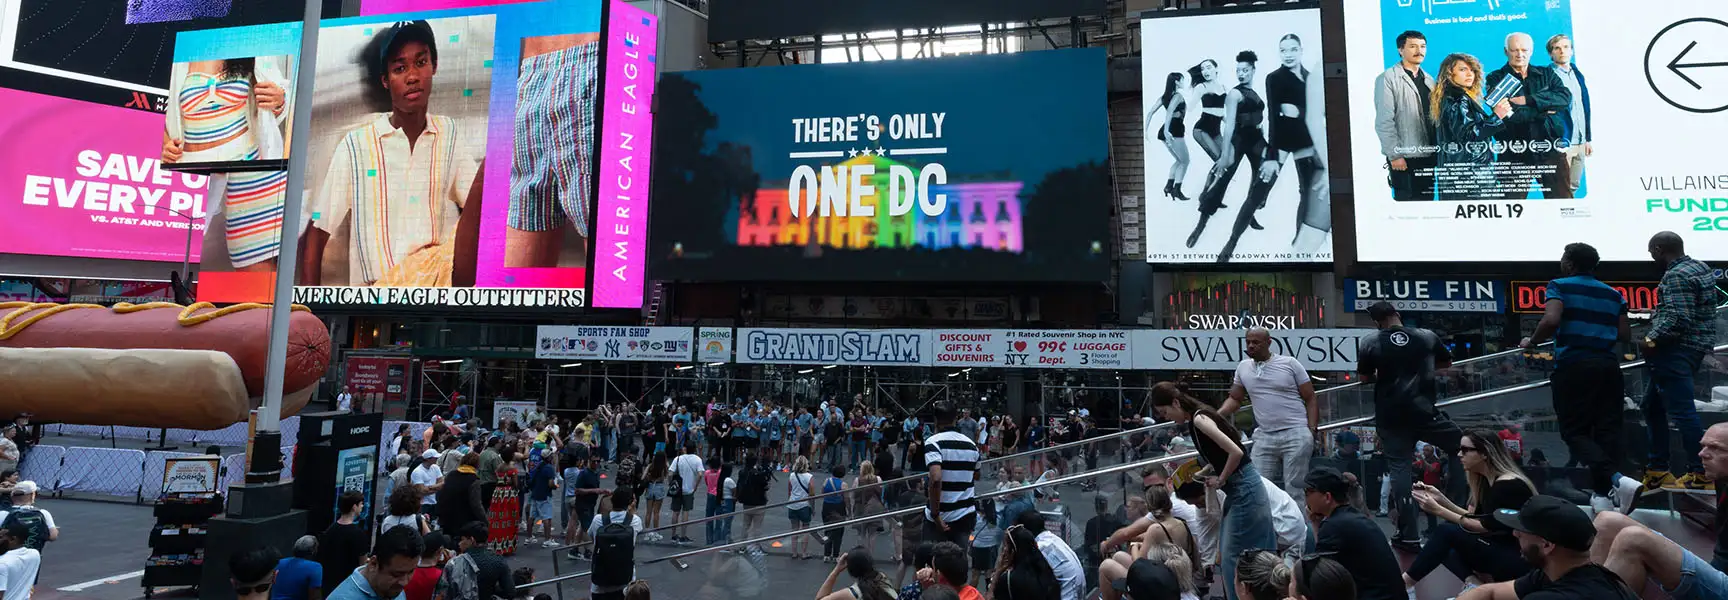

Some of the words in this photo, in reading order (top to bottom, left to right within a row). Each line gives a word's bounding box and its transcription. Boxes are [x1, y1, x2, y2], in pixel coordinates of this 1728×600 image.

[622, 32, 640, 115] EAGLE
[792, 114, 880, 143] THERE'S
[889, 112, 946, 140] ONLY
[76, 150, 172, 186] SAVE
[788, 164, 875, 218] ONE
[889, 162, 947, 216] DC
[1640, 175, 1728, 190] VILLAINS
[23, 174, 166, 216] EVERY
[612, 132, 634, 282] AMERICAN
[1454, 204, 1502, 219] APRIL
[1506, 204, 1523, 218] 19
[90, 215, 109, 224] VS.
[111, 216, 138, 226] AT&T
[140, 218, 164, 228] AND
[293, 288, 382, 304] MERICAN
[388, 289, 448, 305] EAGLE
[454, 290, 584, 306] OUTFITTERS
[1356, 280, 1430, 298] BLUE
[1446, 281, 1494, 299] FIN
[1189, 314, 1295, 330] SWAROVSKI
[577, 327, 608, 337] SPORTS
[610, 328, 627, 337] FAN
[629, 328, 650, 337] SHOP
[940, 334, 992, 342] DISCOUNT
[945, 344, 972, 352] GIFTS
[975, 344, 983, 352] &
[1073, 343, 1126, 351] LUGGAGE
[937, 354, 994, 362] SOUVENIRS
[1005, 354, 1029, 365] NY
[1039, 356, 1066, 365] Dept.
[1080, 353, 1088, 364] 3
